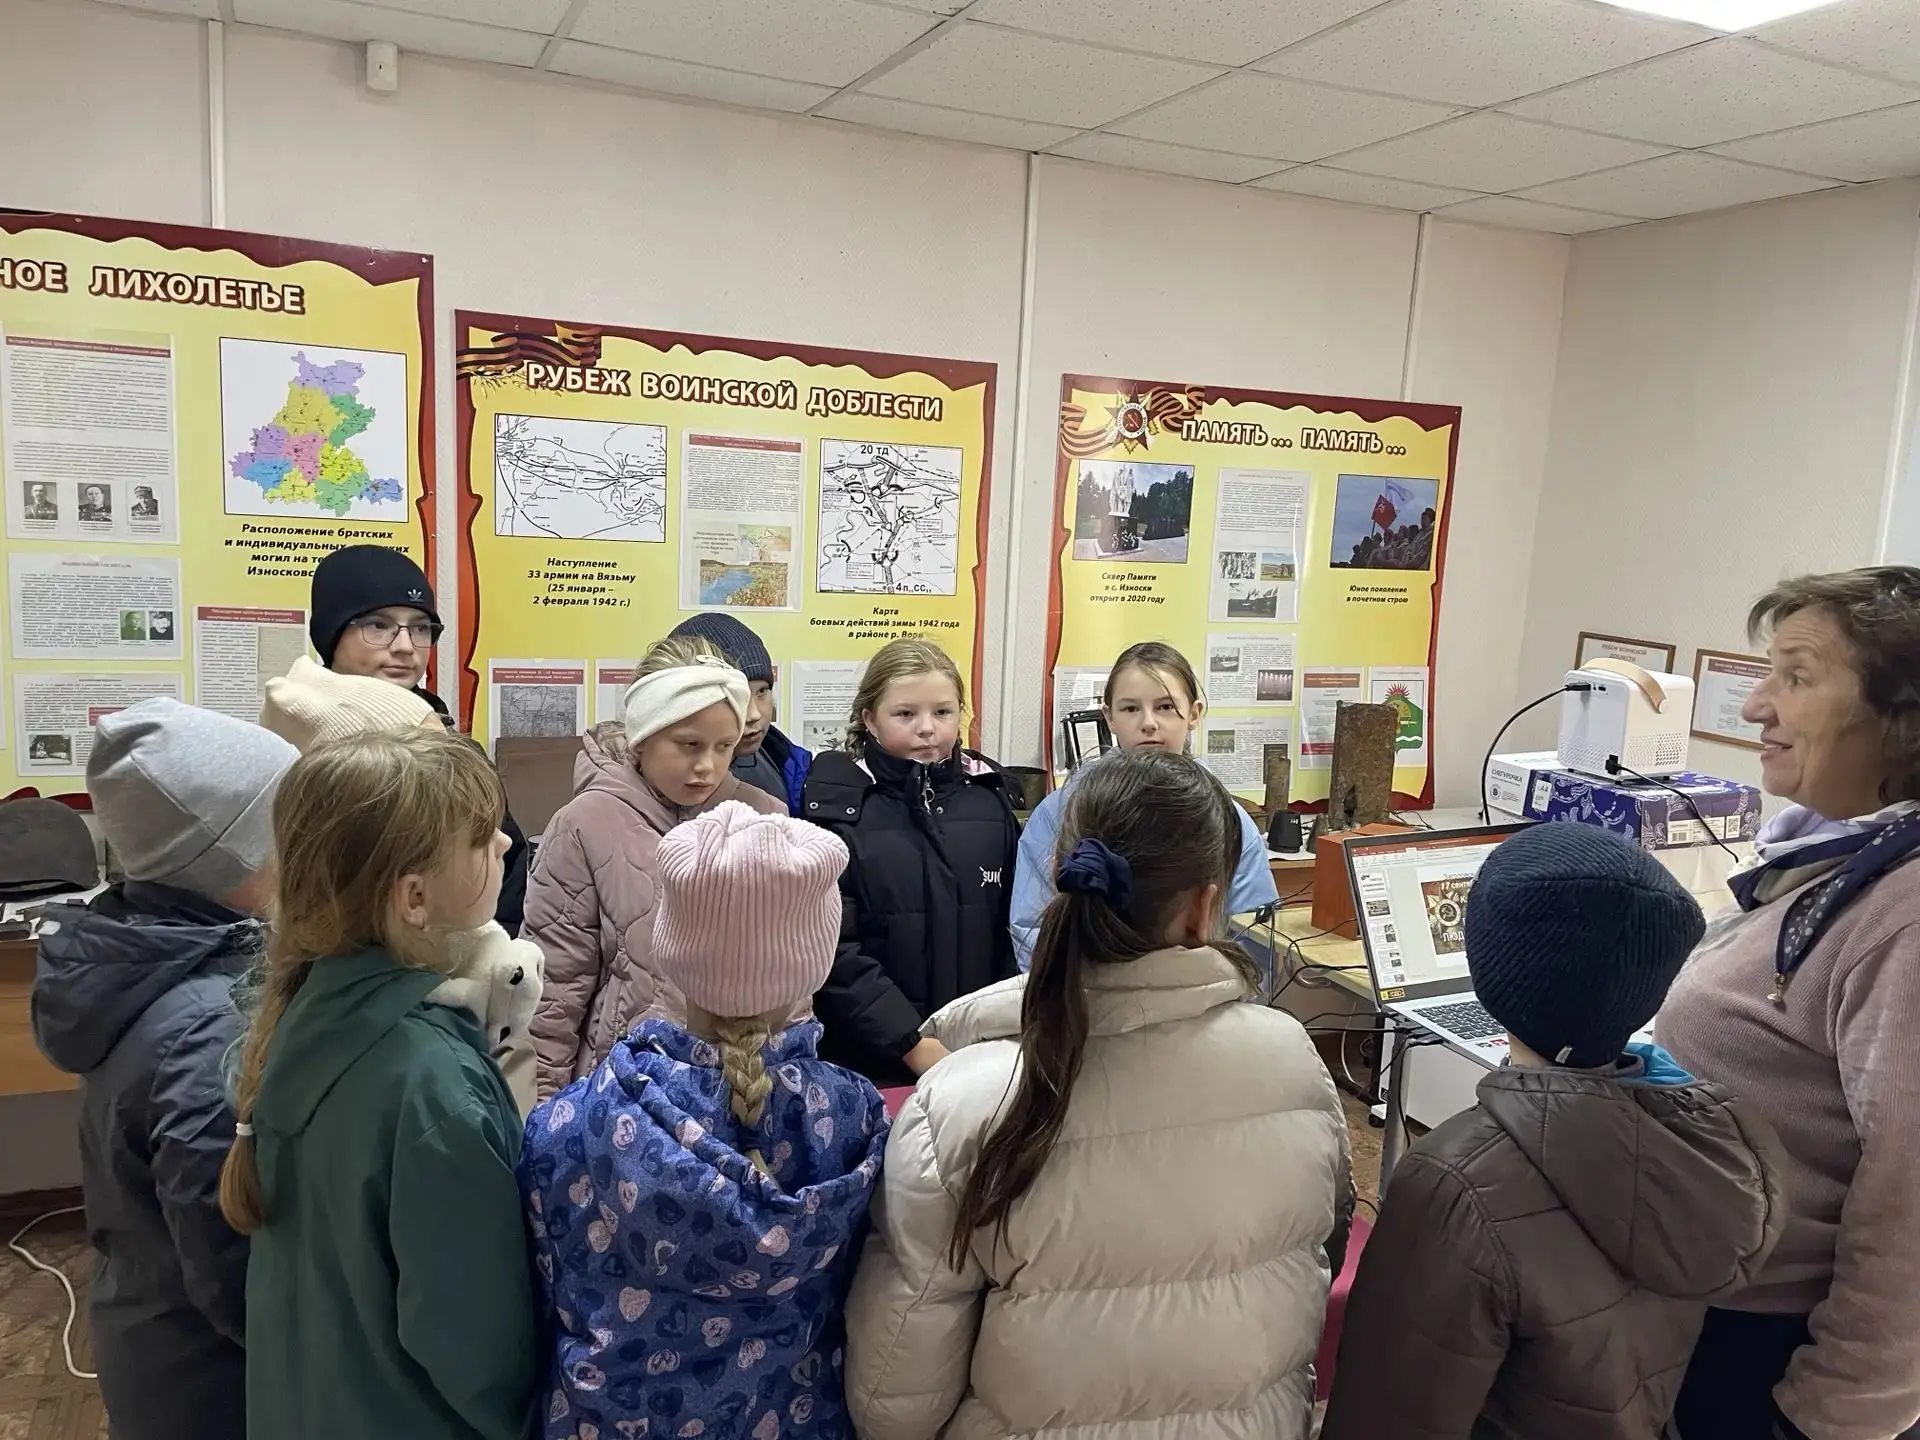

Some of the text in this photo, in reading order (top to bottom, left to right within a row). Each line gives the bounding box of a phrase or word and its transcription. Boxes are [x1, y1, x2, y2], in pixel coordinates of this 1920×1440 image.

[0, 257, 305, 315] НОЕ ЛИХОЛЕТЬЕ
[527, 362, 943, 421] РУБЕЖ ВОИНСКОЙ ДОБЛЕСТИ
[1181, 420, 1268, 446] ПАМЯТЬ
[1300, 428, 1383, 454] ПАМЯТЬ
[860, 444, 873, 455] 20
[242, 524, 393, 539] Расположение братских
[236, 540, 346, 552] индивидуальных
[251, 554, 290, 563] могил
[293, 555, 308, 563] на
[547, 557, 617, 569] Наступление
[248, 566, 314, 577] Износковс
[528, 570, 541, 578] 33
[544, 572, 579, 581] армии
[597, 572, 636, 583] Вязьму
[1102, 572, 1157, 581] Сквер Памяти
[548, 583, 564, 593] (25
[566, 585, 606, 595] января
[896, 583, 902, 591] 4
[1119, 583, 1152, 591] Износки
[533, 596, 631, 607] 2 февраля 1942 г.)
[1090, 595, 1119, 603] открыт
[1147, 596, 1165, 604] году
[873, 607, 899, 616] Карта
[810, 618, 845, 626] боевых
[846, 618, 889, 628] действий
[855, 631, 889, 639] районе
[890, 632, 899, 640] р.
[1441, 881, 1470, 890] 17 сент
[1443, 931, 1465, 942] ЛЮД
